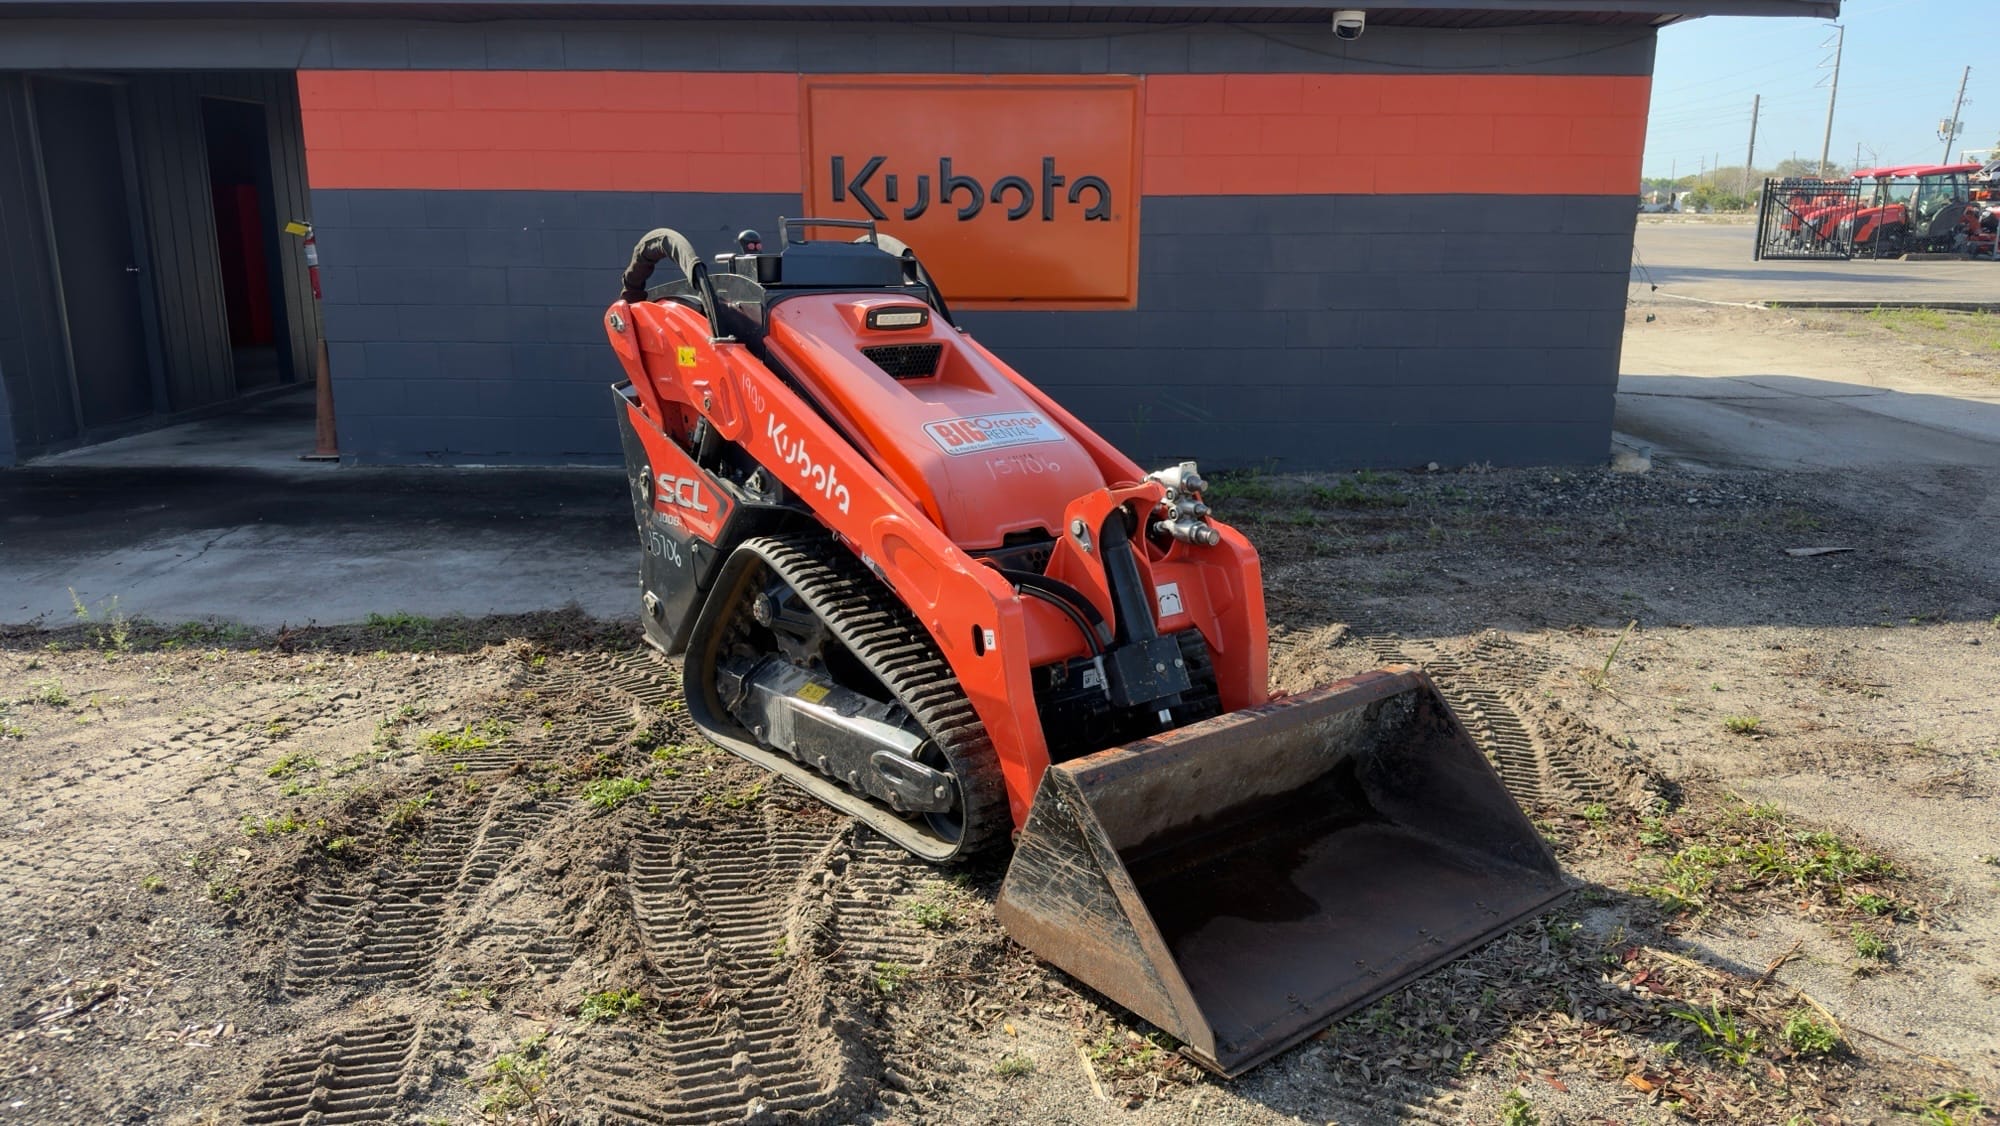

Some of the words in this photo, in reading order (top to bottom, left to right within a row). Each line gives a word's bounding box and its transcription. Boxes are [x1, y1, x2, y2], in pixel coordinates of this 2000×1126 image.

[831, 156, 1112, 221] Kubota
[933, 419, 988, 447] BIG
[975, 416, 1043, 429] Orange
[986, 425, 1035, 441] RENTAL
[767, 412, 850, 515] Kubota
[658, 473, 709, 512] SCL
[648, 530, 682, 568] 15706
